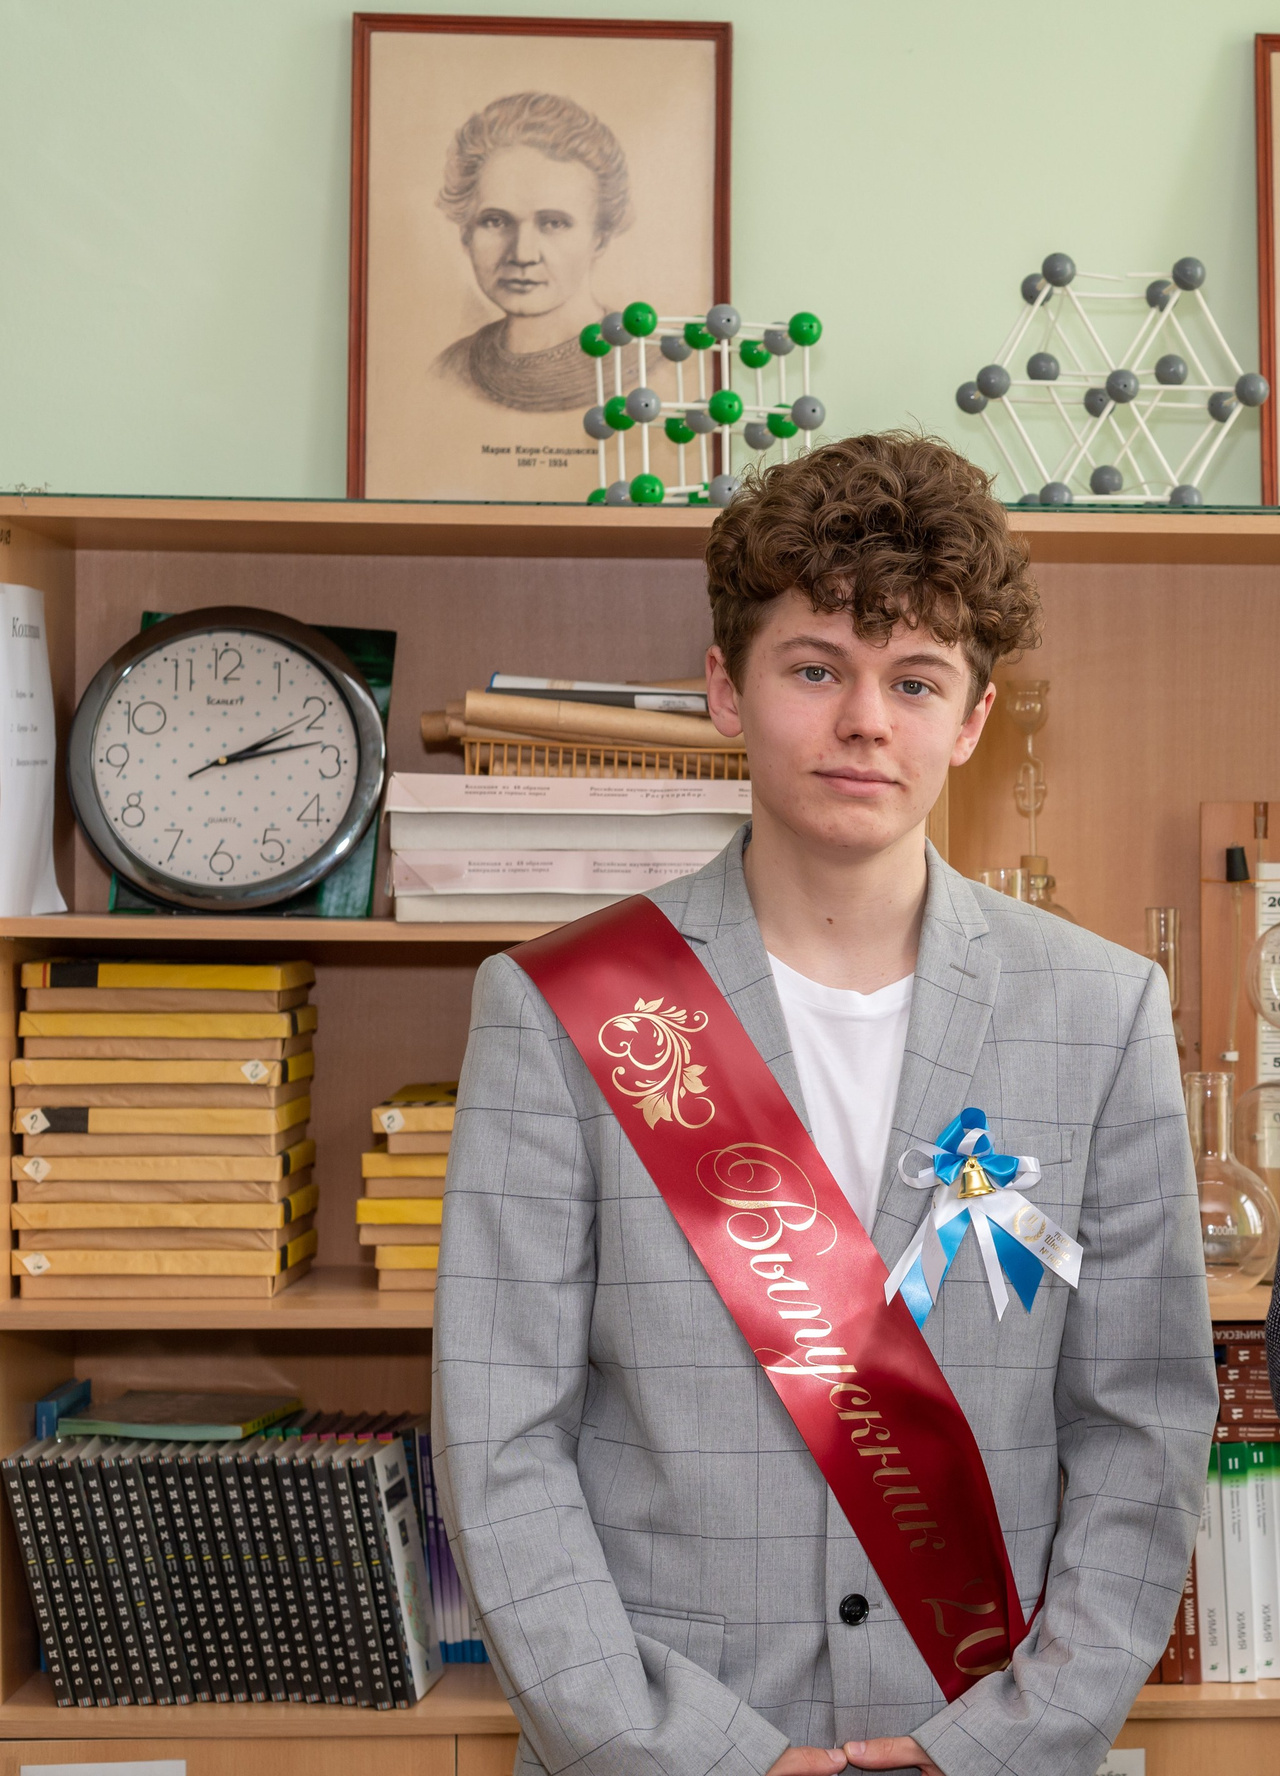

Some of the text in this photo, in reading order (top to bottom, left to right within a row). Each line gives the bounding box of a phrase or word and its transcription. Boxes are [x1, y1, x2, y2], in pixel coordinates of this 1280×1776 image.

[481, 445, 598, 456] Мария Кюри-Склодовска
[171, 658, 194, 692] 11
[212, 647, 243, 681] 12
[273, 661, 282, 694] 1
[124, 701, 166, 735] 10
[303, 697, 327, 730] 2
[106, 744, 129, 778] 9
[319, 744, 341, 778] 3
[122, 793, 145, 828] 8
[297, 794, 323, 826] 4
[164, 829, 183, 862] 7
[209, 842, 234, 875] 6
[260, 829, 285, 863] 5
[1208, 1224, 1237, 1236] 000ml
[695, 1142, 946, 1558] Выпускник
[1213, 1330, 1265, 1340] НИЧЕСКА
[1228, 1369, 1239, 1381] 11
[1238, 1350, 1250, 1362] 11
[1224, 1389, 1236, 1401] 11
[1231, 1408, 1243, 1420] 11
[1217, 1426, 1228, 1438] 11
[1228, 1458, 1239, 1470] 11
[1253, 1451, 1264, 1463] 11
[9, 1479, 64, 1687] задачник химия
[27, 1478, 84, 1686] задачник химия
[46, 1479, 103, 1686] задачник химия
[64, 1480, 123, 1685] задачник химия
[88, 1478, 144, 1685] задачник химия
[109, 1479, 164, 1686] задачник химия
[125, 1477, 182, 1683] задачник химия
[147, 1475, 202, 1681] задачник химия
[165, 1475, 222, 1681] задачник химия
[184, 1476, 239, 1682] задачник химия
[204, 1475, 258, 1681] задачник химия
[225, 1475, 278, 1681] задачник химия
[243, 1475, 295, 1681] задачник химия
[260, 1476, 312, 1683] задачник химия
[282, 1477, 332, 1684] задачник химия
[299, 1477, 349, 1684] задачник химия
[337, 1481, 384, 1690] задачник химия
[356, 1479, 402, 1688] задачник химия
[1184, 1597, 1196, 1636] ХИМИЯ
[1207, 1608, 1218, 1647] ХИМИЯ
[1236, 1612, 1247, 1650] ХИМИЯ
[1261, 1604, 1273, 1643] ХИМИЯ
